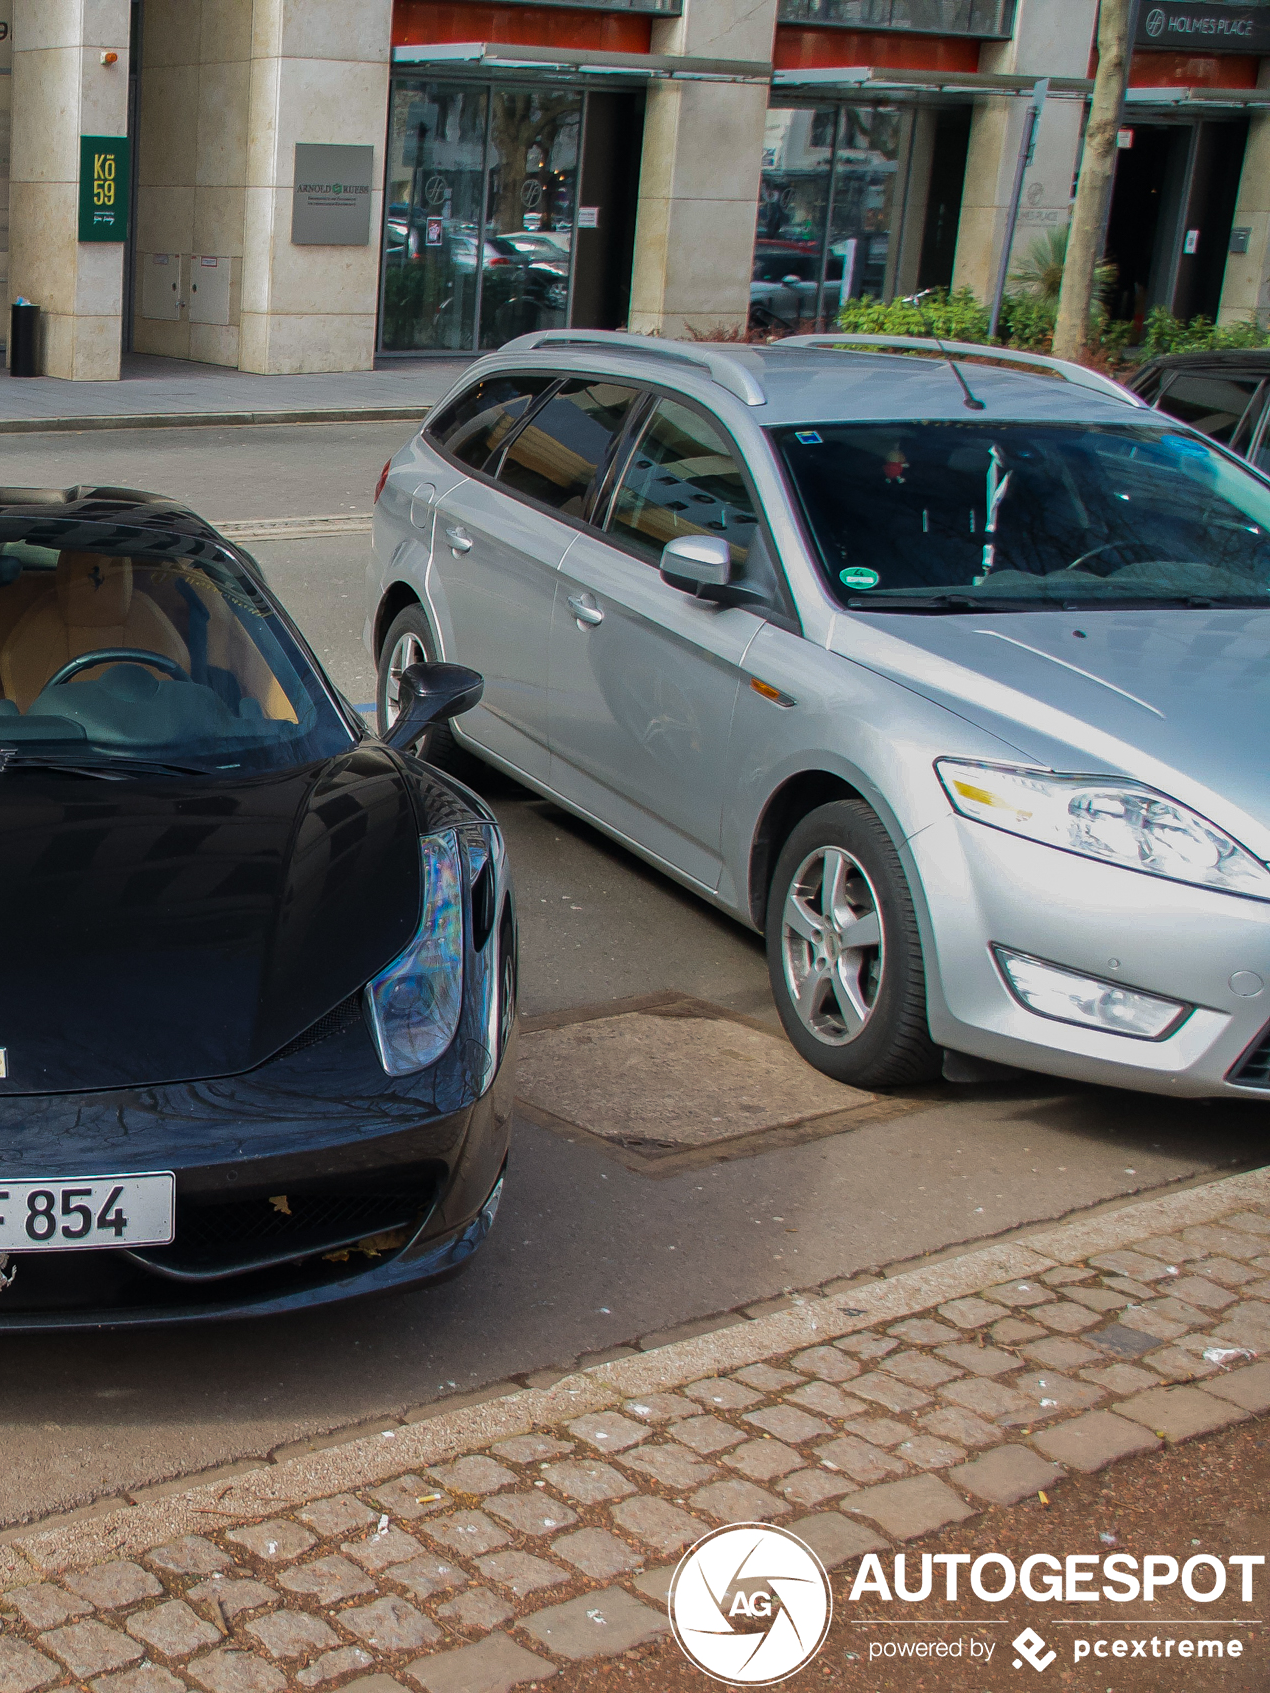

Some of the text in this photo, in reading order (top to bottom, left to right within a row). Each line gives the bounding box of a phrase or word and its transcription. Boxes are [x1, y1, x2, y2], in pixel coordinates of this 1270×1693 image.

[1168, 16, 1253, 36] HOLMES PLACE
[93, 180, 115, 205] 59
[297, 184, 332, 194] ARNOLD
[25, 1186, 127, 1241] 854
